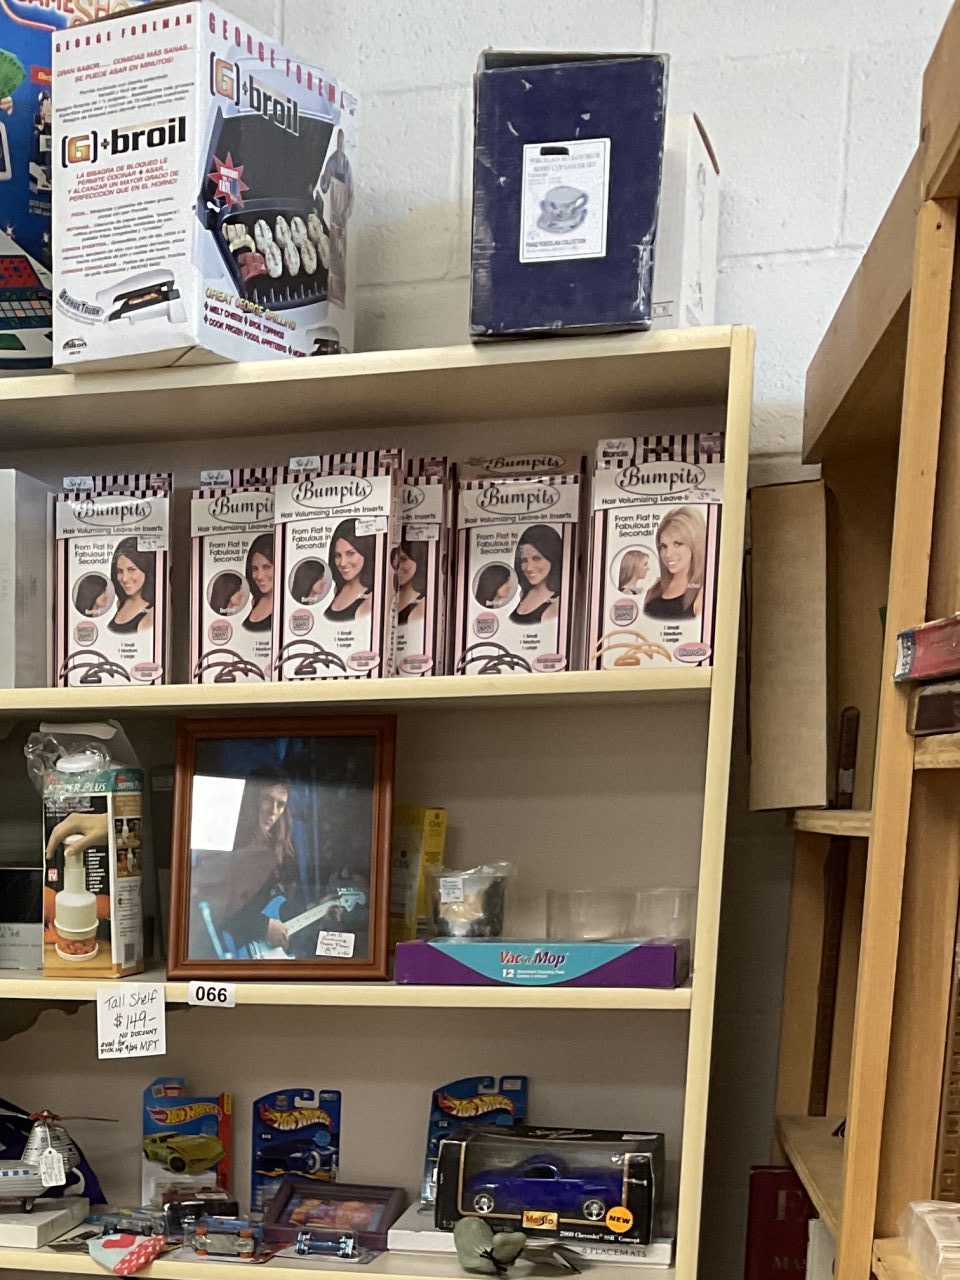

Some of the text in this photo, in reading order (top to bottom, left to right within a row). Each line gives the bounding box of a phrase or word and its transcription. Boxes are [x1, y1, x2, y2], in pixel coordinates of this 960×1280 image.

[56, 31, 111, 52] GEORGE
[209, 12, 275, 68] GEORGE
[620, 466, 700, 488] Bumpits
[295, 480, 369, 502] Bumpits
[483, 486, 556, 511] Bumpits
[500, 951, 566, 967] Vac Mop
[502, 969, 514, 978] 12
[129, 990, 158, 1007] Shelf
[196, 986, 228, 1003] 066
[608, 1215, 630, 1225] NEW
[589, 1247, 647, 1258] PLACEMATS
